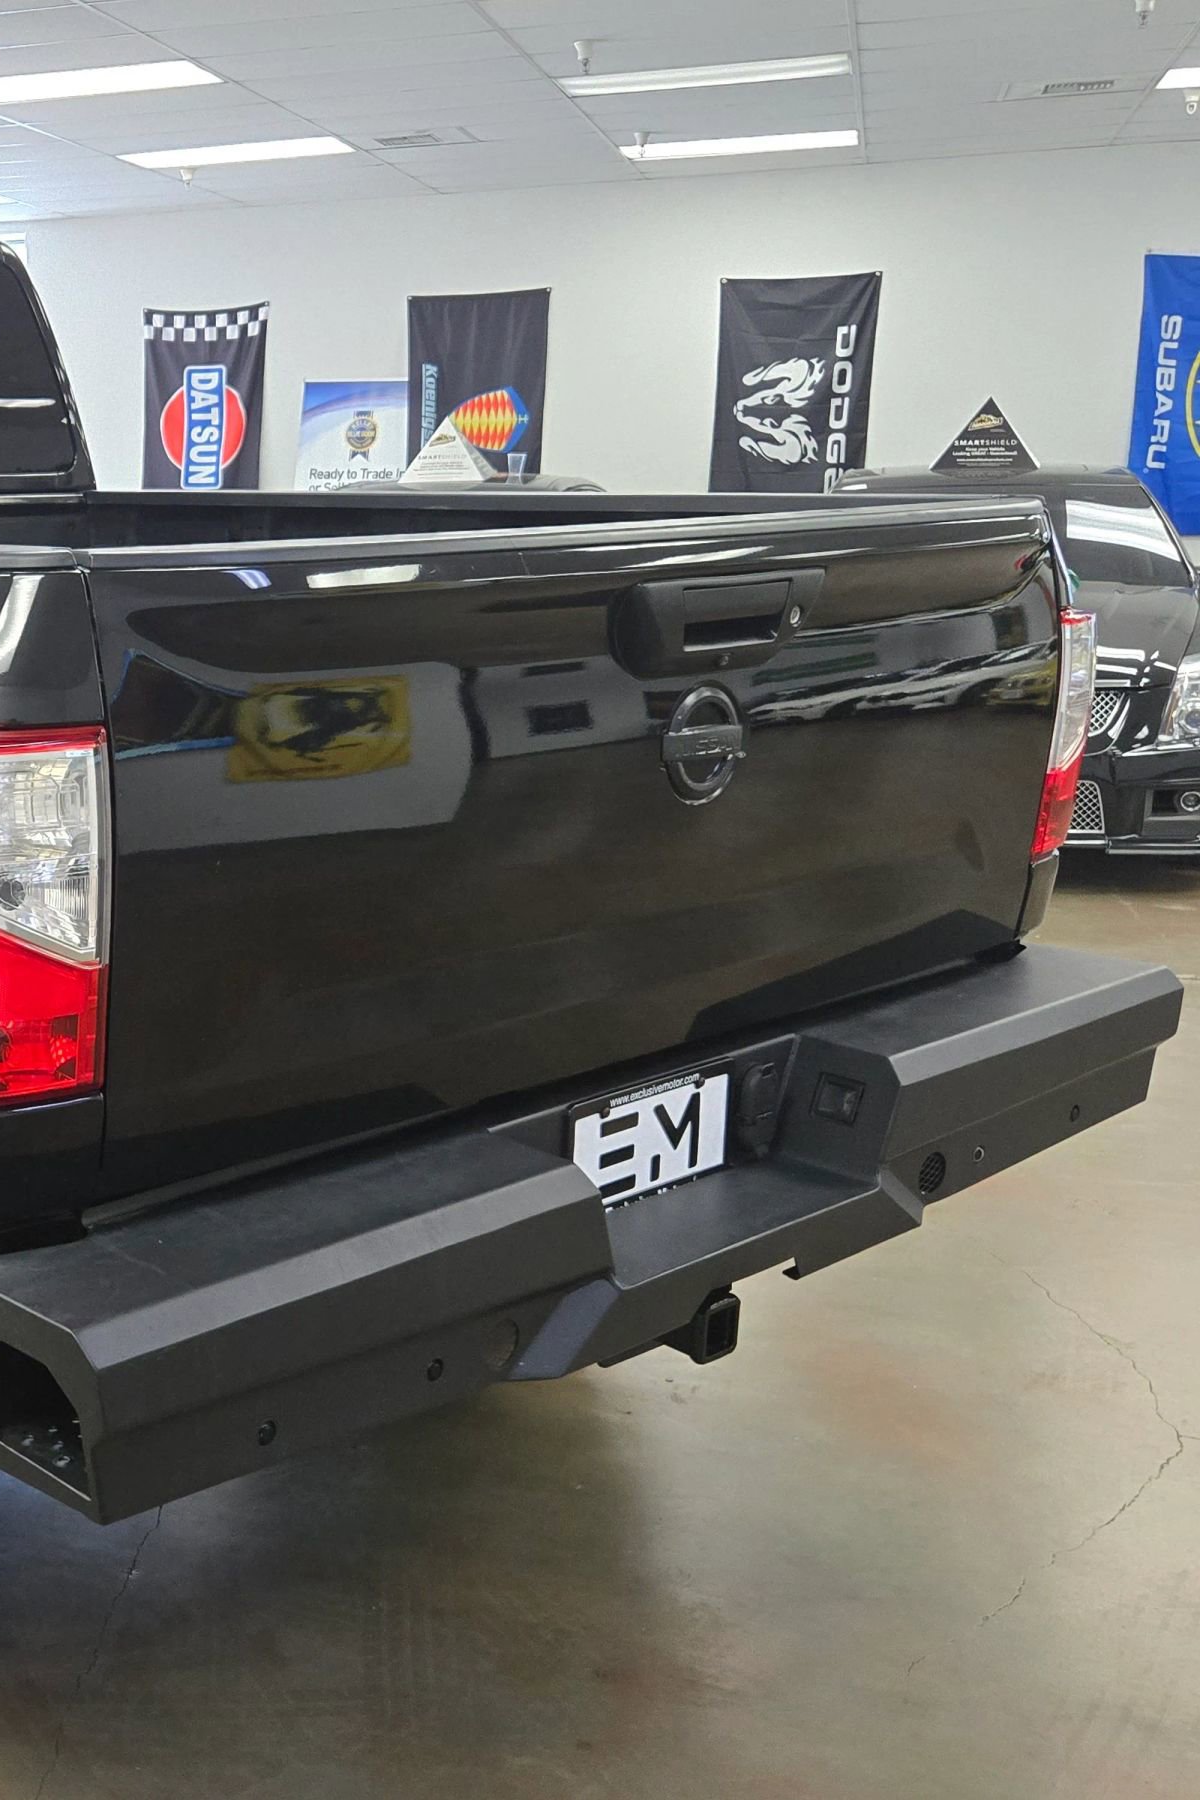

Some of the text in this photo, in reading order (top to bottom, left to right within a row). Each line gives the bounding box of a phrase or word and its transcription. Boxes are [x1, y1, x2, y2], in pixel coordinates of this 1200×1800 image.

[188, 372, 219, 484] DATSUN
[824, 324, 857, 494] DODGE
[1145, 314, 1183, 469] SUBARU
[309, 468, 344, 481] Ready
[346, 468, 358, 479] to
[361, 468, 393, 480] Trade
[610, 1072, 700, 1107] www.exclusivemotor.com
